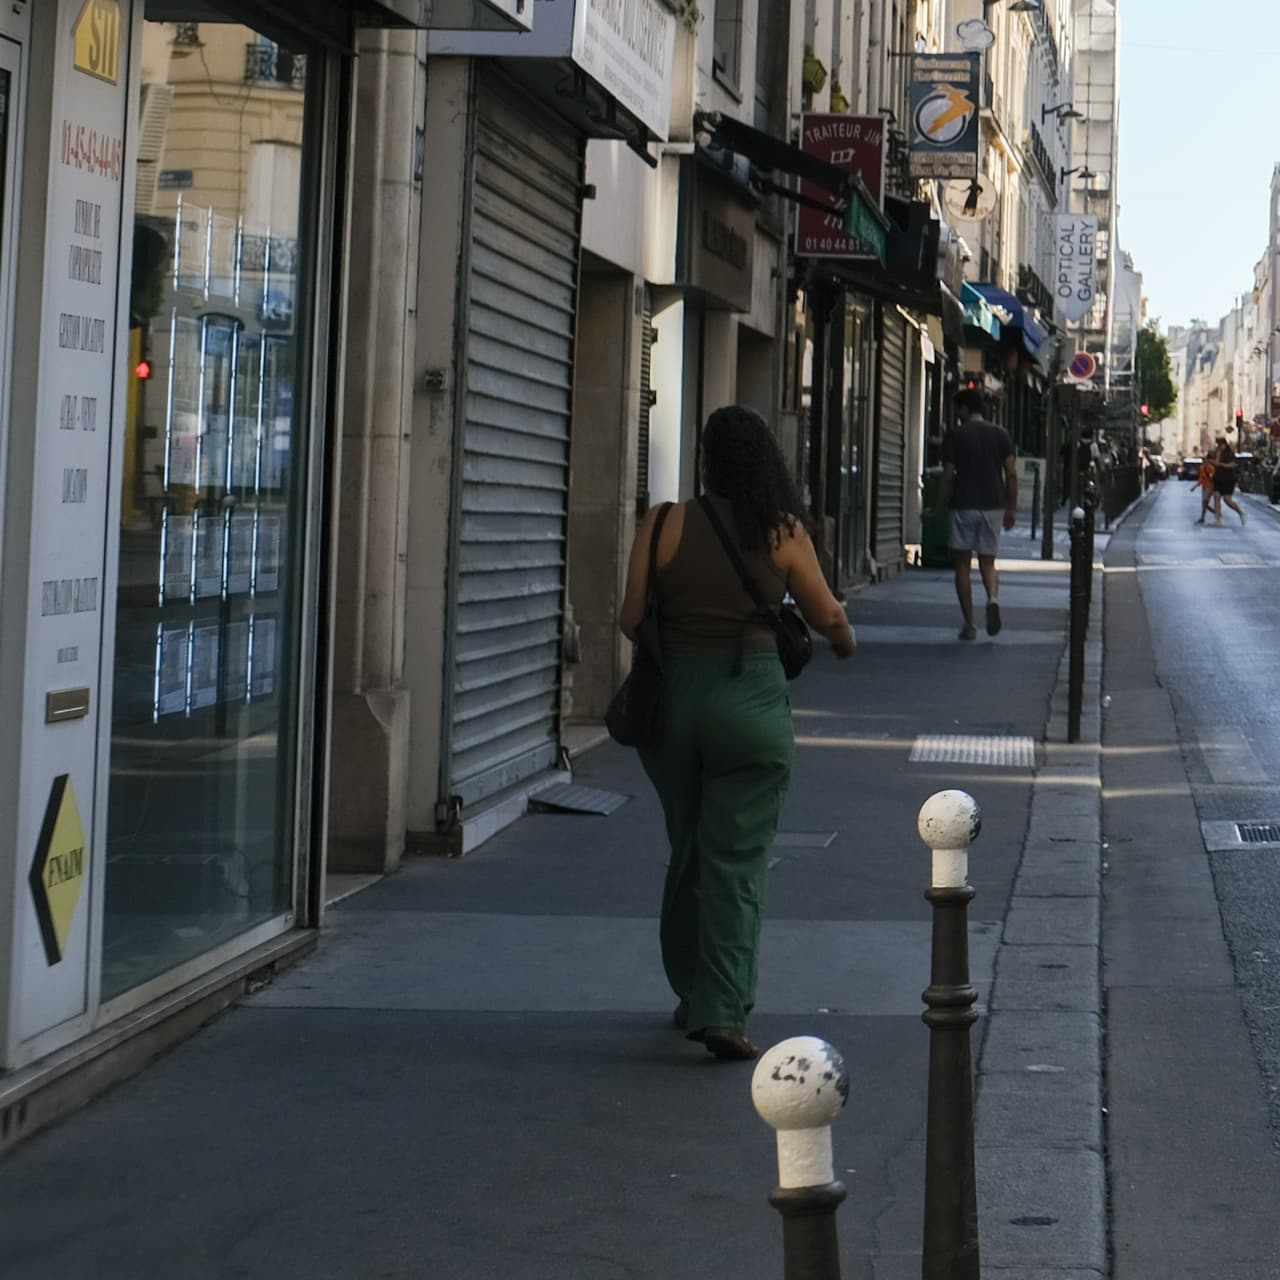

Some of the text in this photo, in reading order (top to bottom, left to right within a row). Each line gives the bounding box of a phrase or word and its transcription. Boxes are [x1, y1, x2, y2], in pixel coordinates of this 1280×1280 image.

[88, 1, 116, 78] STI
[805, 123, 862, 144] TRAITEUR
[834, 237, 846, 250] 44
[1058, 223, 1075, 298] OPTICAL
[1077, 220, 1094, 302] GALLERY
[48, 846, 83, 887] FNAIM
